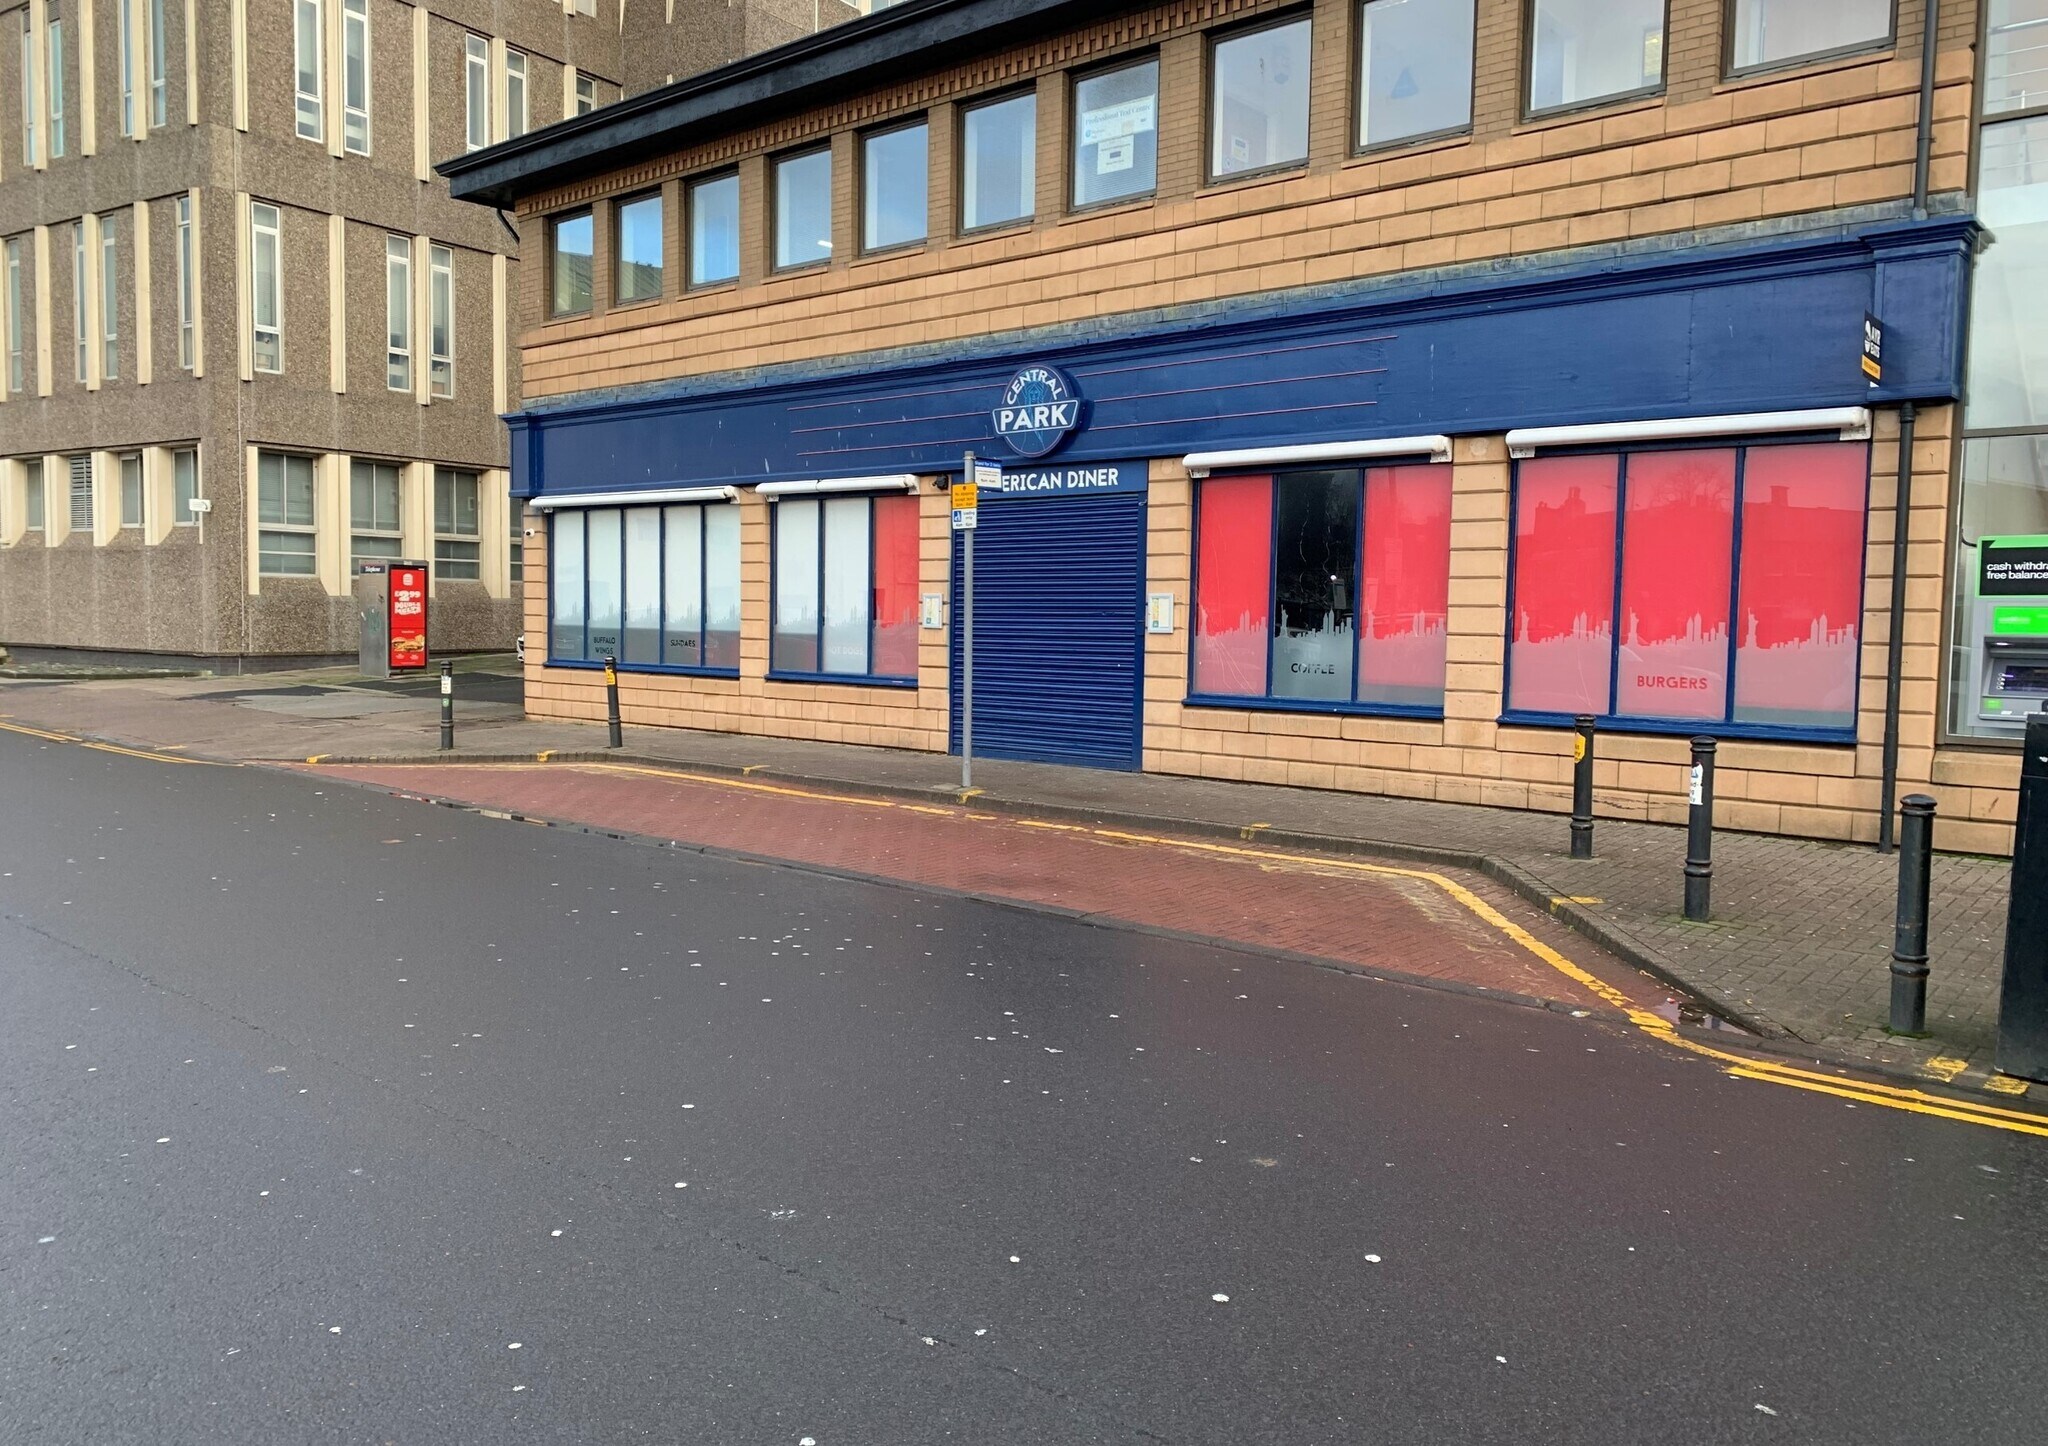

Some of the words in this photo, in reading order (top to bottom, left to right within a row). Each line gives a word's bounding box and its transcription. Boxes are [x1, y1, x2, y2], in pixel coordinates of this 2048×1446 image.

[1007, 369, 1062, 405] CENTRAL
[1000, 403, 1068, 431] PARK
[977, 471, 1062, 493] ERICAN
[1067, 468, 1119, 488] DINER
[1986, 562, 2012, 571] cash
[1986, 570, 2007, 579] free
[593, 636, 616, 644] BUFFALO
[1636, 675, 1708, 689] BURGERS
